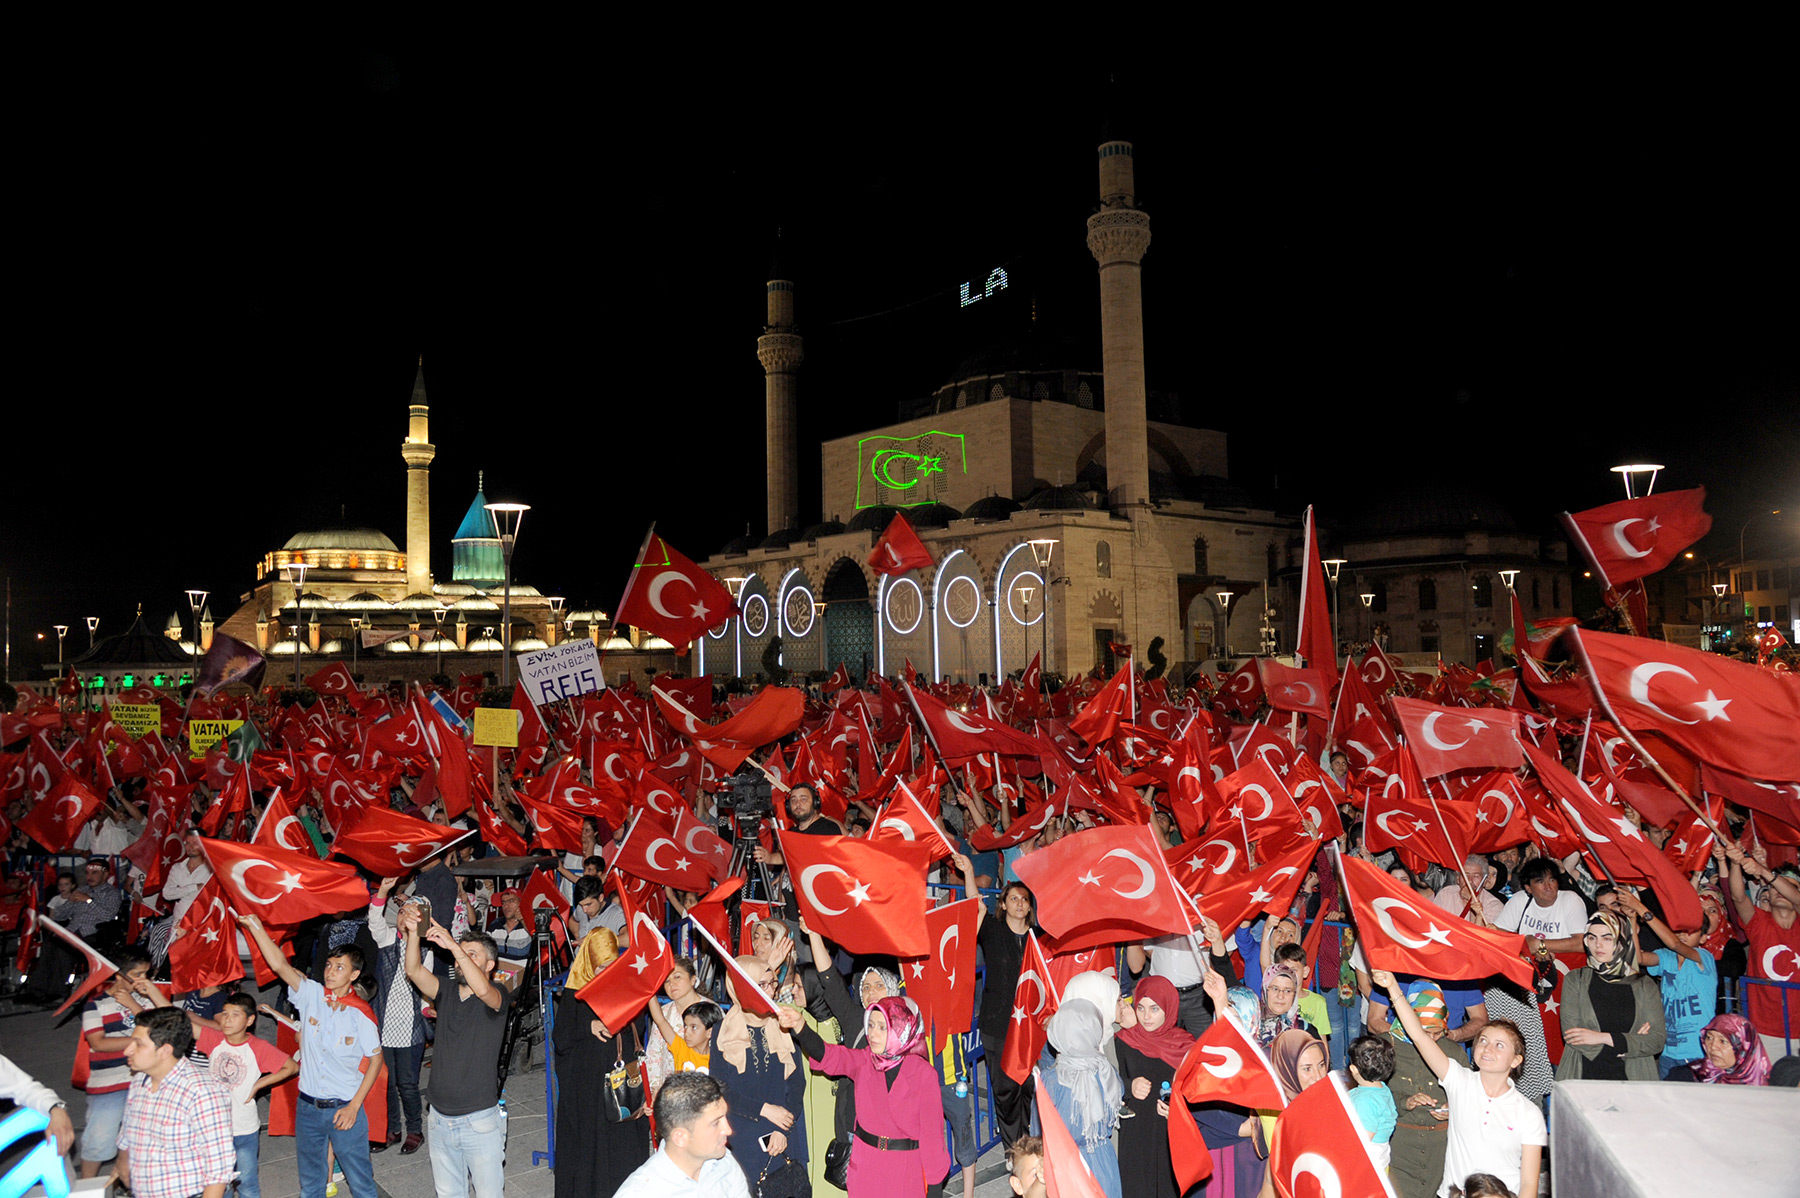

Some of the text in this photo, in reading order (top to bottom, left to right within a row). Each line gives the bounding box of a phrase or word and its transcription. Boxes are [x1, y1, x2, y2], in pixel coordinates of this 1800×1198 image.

[960, 267, 1008, 308] LA
[529, 661, 567, 678] VATAN
[192, 723, 229, 735] VATAN
[1524, 914, 1561, 933] TURKEY
